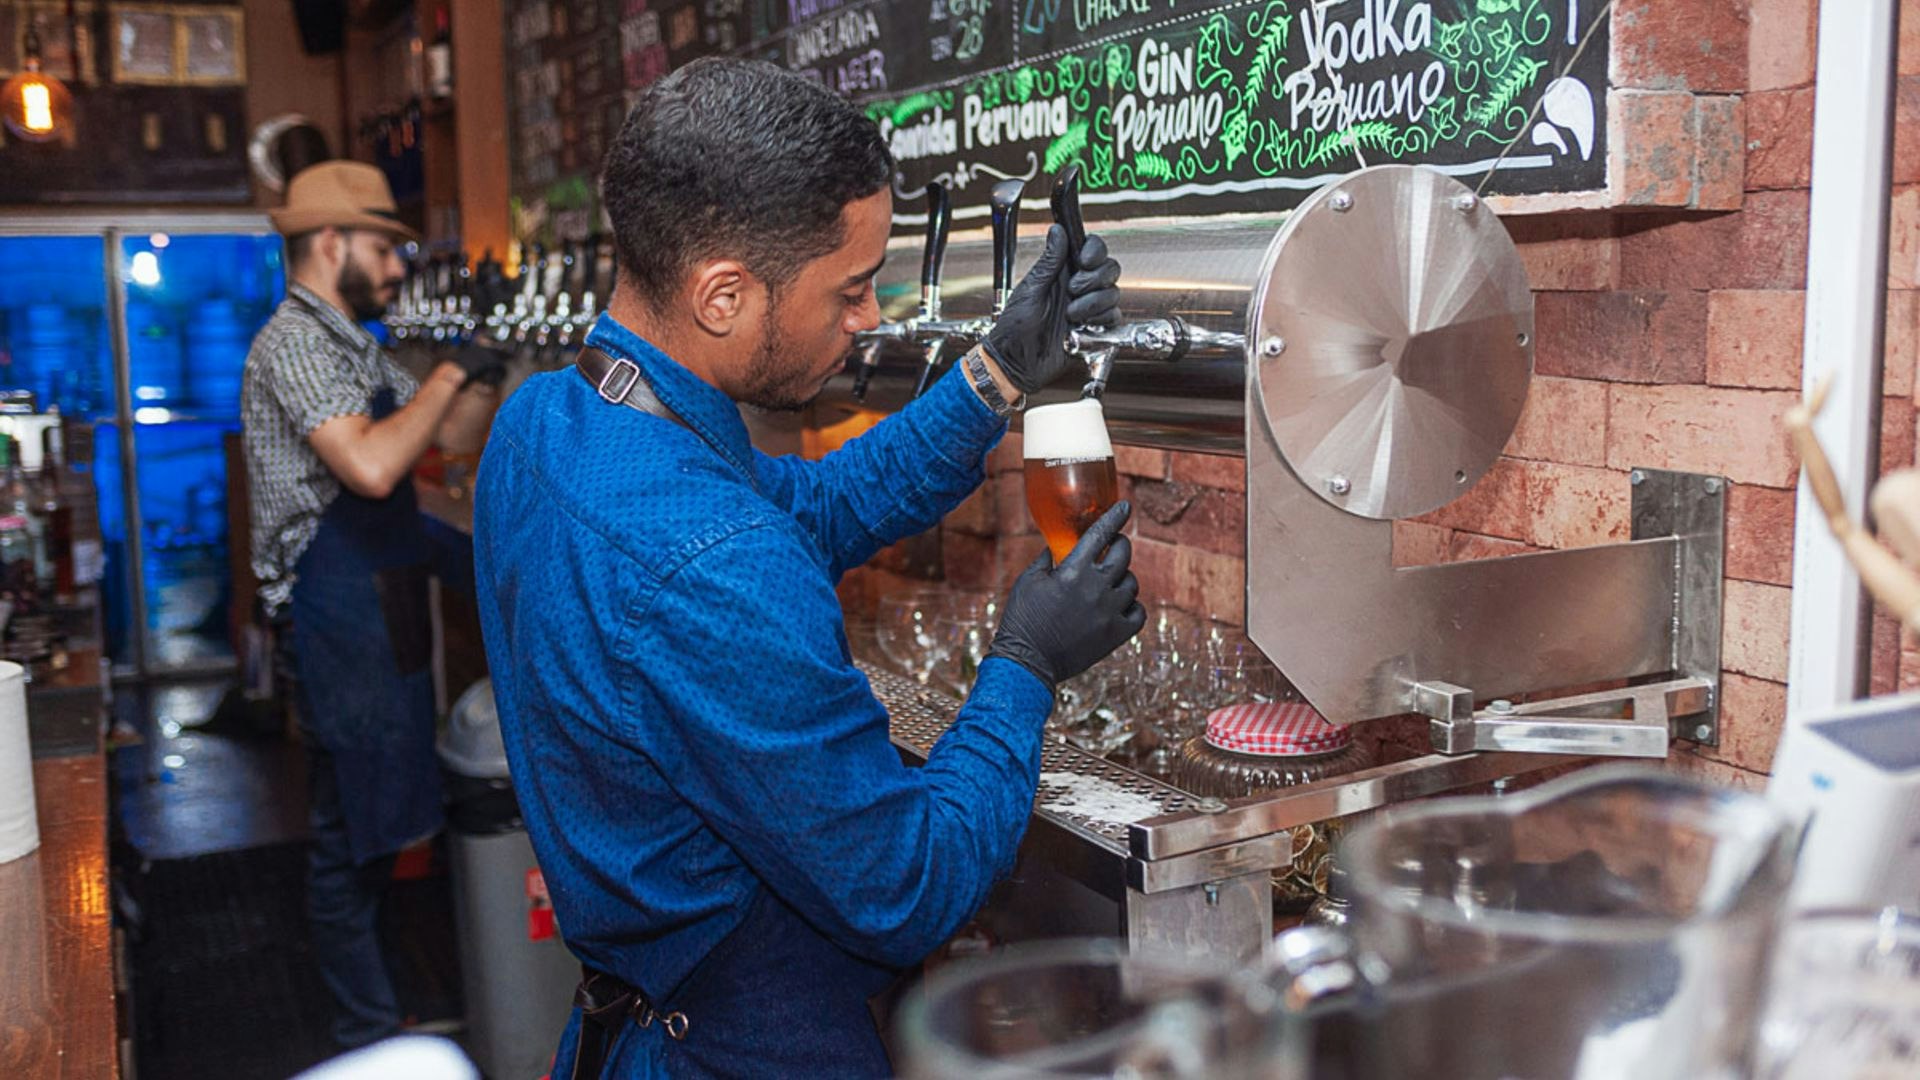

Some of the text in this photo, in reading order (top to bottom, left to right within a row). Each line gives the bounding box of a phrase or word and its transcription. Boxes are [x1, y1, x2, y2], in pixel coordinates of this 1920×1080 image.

[963, 94, 1068, 150] Peruana
[1112, 91, 1224, 160] Peruano
[1284, 61, 1446, 133] Peruano
